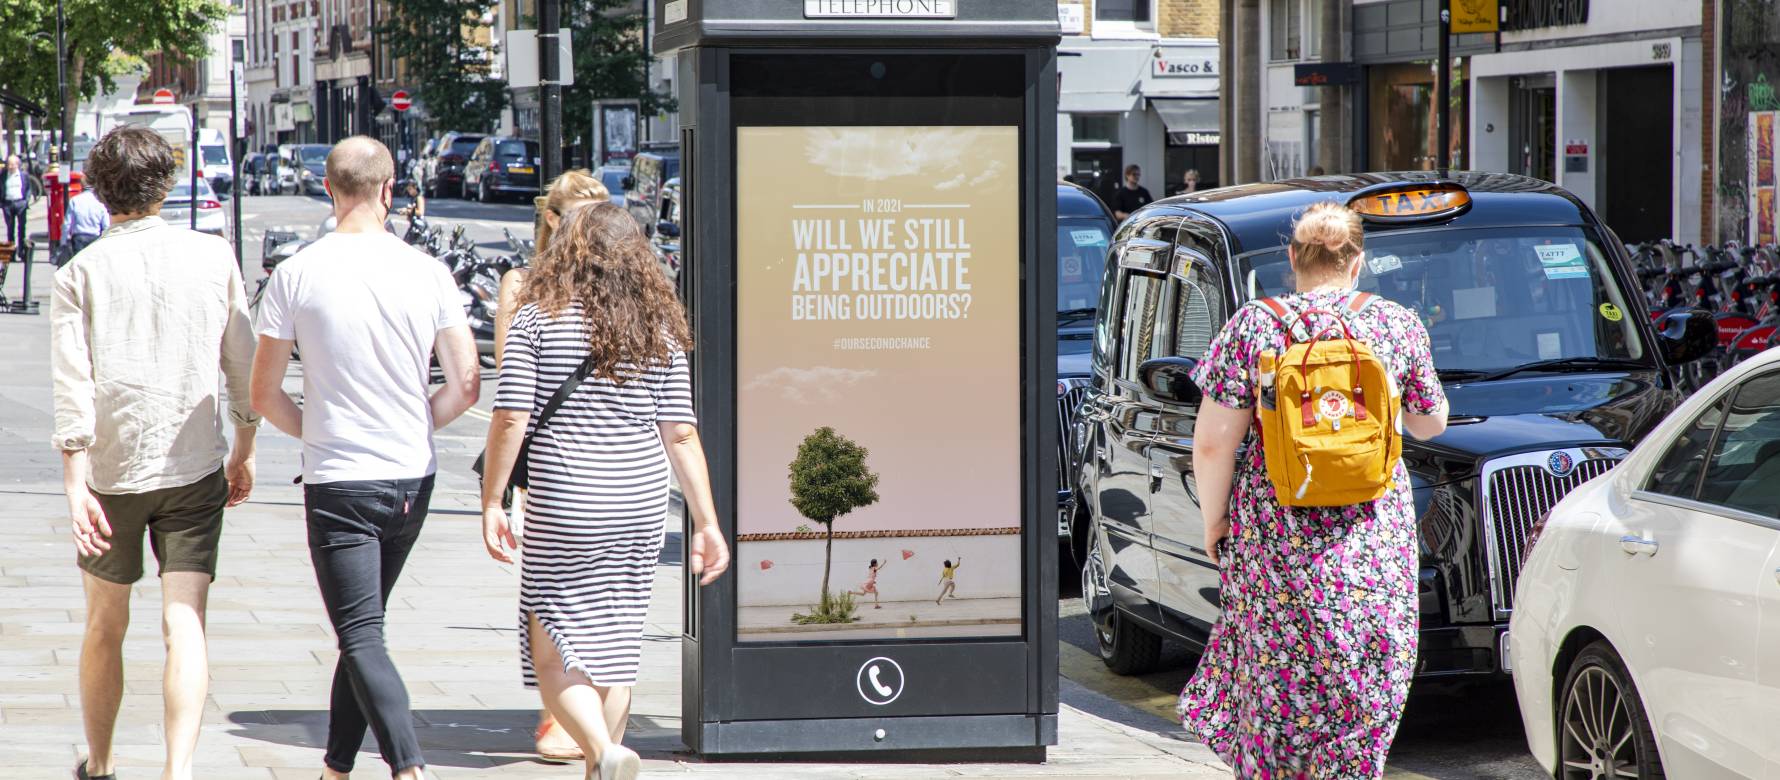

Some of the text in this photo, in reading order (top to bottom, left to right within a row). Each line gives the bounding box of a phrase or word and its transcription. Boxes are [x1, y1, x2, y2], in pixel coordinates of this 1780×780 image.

[818, 0, 944, 14] TELEPHONE
[1158, 60, 1213, 73] Vasco &
[863, 199, 901, 213] IN 2021
[792, 218, 971, 250] WILL WE STILL
[792, 252, 972, 291] APPRECIATE
[792, 293, 972, 321] BEING OUTDOORS?
[832, 337, 931, 350] #OURSECONDCHANCE
